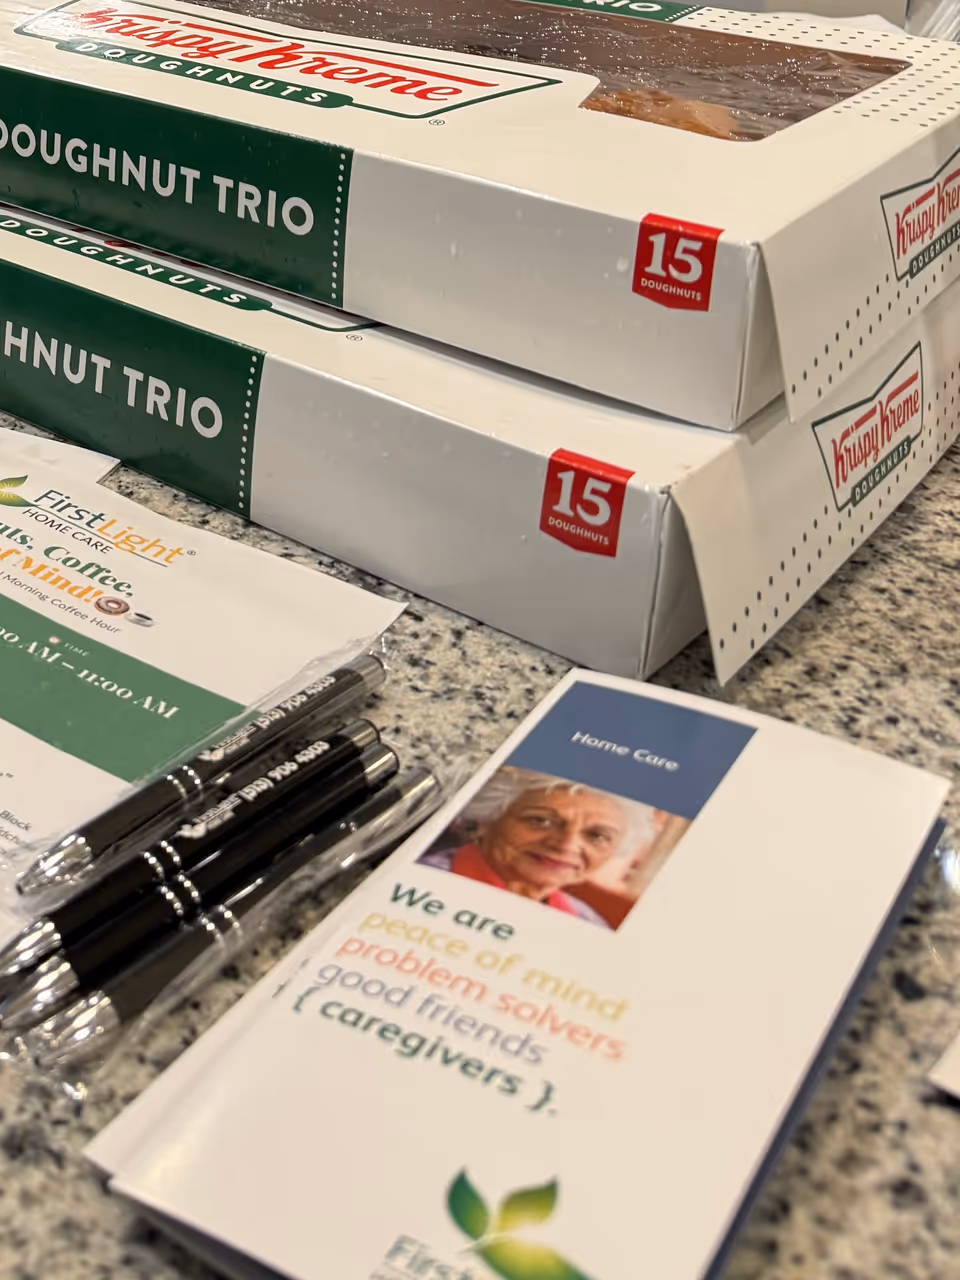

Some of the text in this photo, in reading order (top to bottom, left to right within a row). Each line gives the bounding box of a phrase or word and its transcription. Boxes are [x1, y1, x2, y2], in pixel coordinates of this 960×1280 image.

[73, 7, 499, 103] Krispy Kreme
[74, 41, 329, 104] DOUGHNUTS
[213, 175, 314, 236] TRIO
[643, 231, 703, 283] 15
[641, 277, 701, 302] DOUGHNUTS
[123, 366, 224, 439] TRIO
[831, 370, 921, 491] Krispy Kreme
[552, 470, 612, 526] 15
[854, 439, 910, 501] DOUGHNUTS
[22, 506, 114, 554] HOME CARE
[33, 488, 187, 565] FirstLight
[548, 516, 609, 546] DOUGHNUTS
[13, 555, 104, 604] Mind!
[43, 545, 135, 598] Coffee,
[3, 571, 48, 602] Morning
[50, 598, 89, 621] Coffee
[89, 616, 123, 635] Hour
[19, 639, 61, 664] AM
[75, 668, 134, 700] 11:00
[133, 695, 181, 719] AM
[63, 642, 90, 657] TIME
[255, 674, 336, 730] (513) 906 4303
[240, 739, 331, 802] (513) 906 4303
[571, 730, 680, 772] Home Care
[389, 882, 517, 942] We are
[355, 910, 631, 1023] peace of mind
[316, 960, 551, 1067] good friends
[335, 935, 628, 1063] problem solvers
[318, 995, 524, 1099] caregivers
